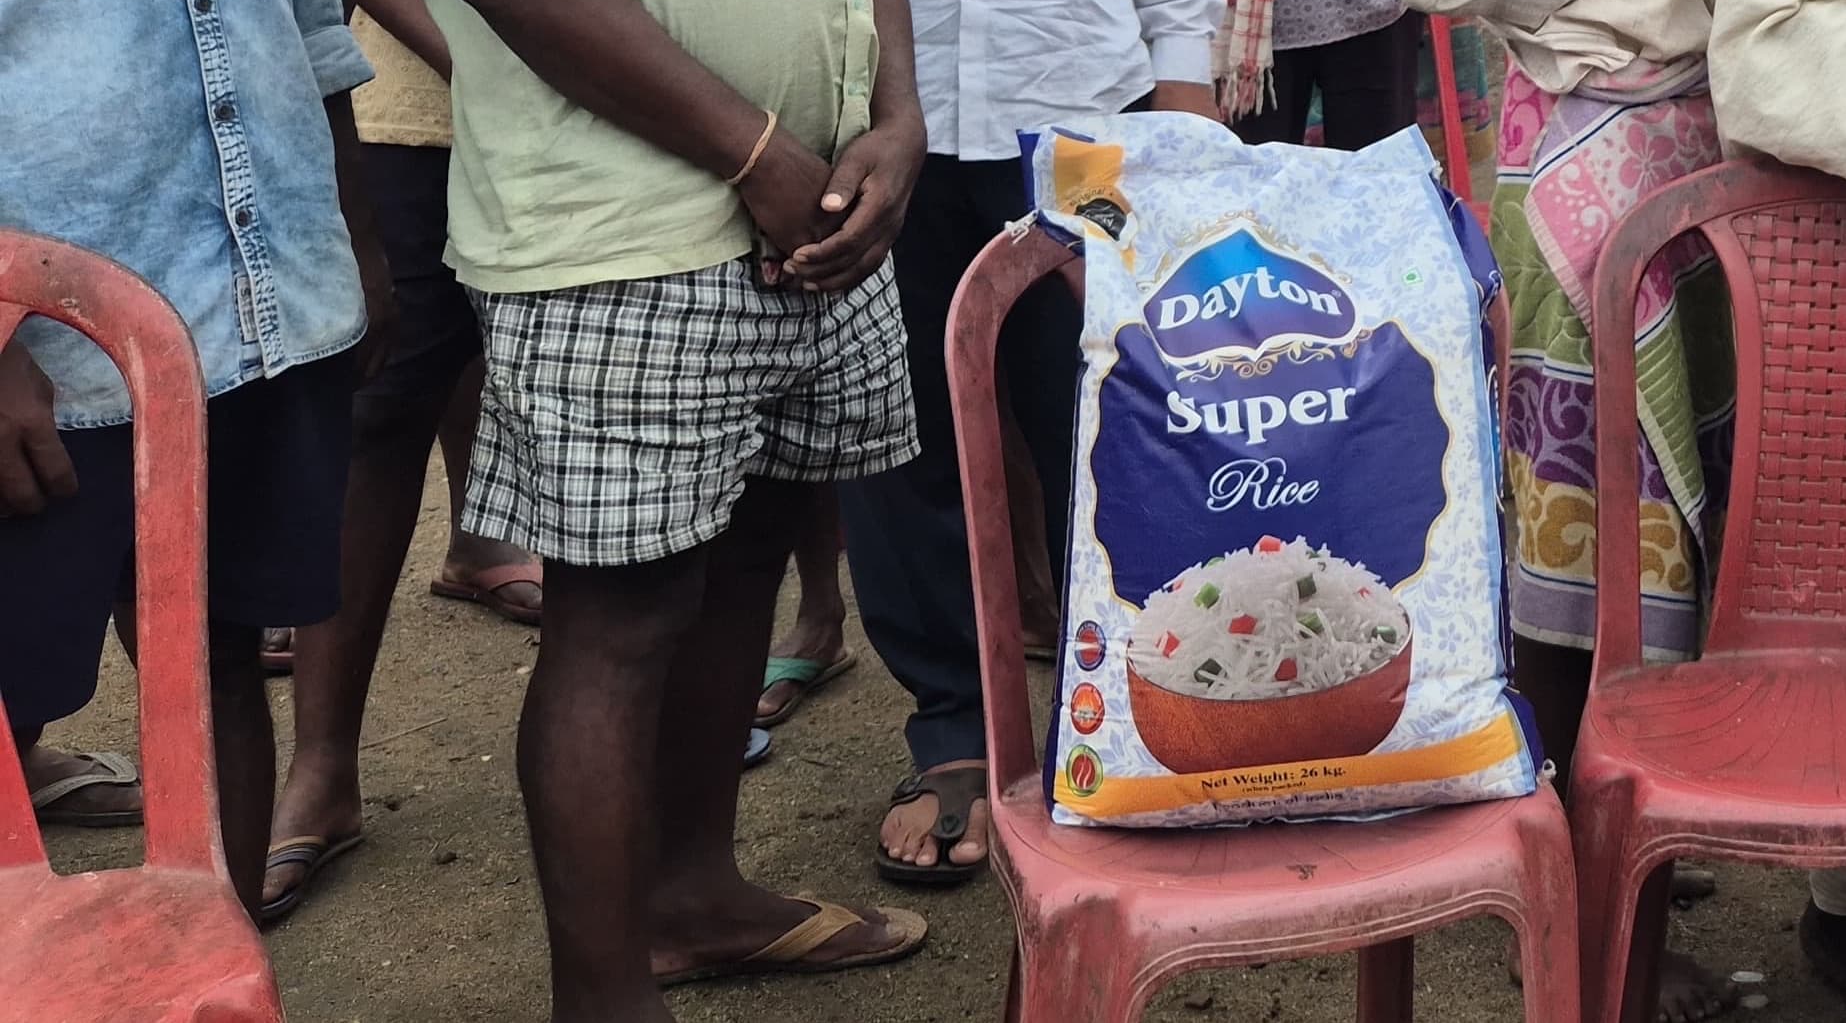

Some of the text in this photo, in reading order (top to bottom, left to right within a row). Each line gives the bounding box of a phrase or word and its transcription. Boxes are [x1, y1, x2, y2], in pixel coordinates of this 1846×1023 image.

[1157, 266, 1342, 329] Dayton
[1167, 387, 1356, 445] Super
[1206, 457, 1320, 511] Rice
[1201, 777, 1228, 791] Net
[1233, 771, 1294, 785] Weight:
[1301, 768, 1319, 779] 26
